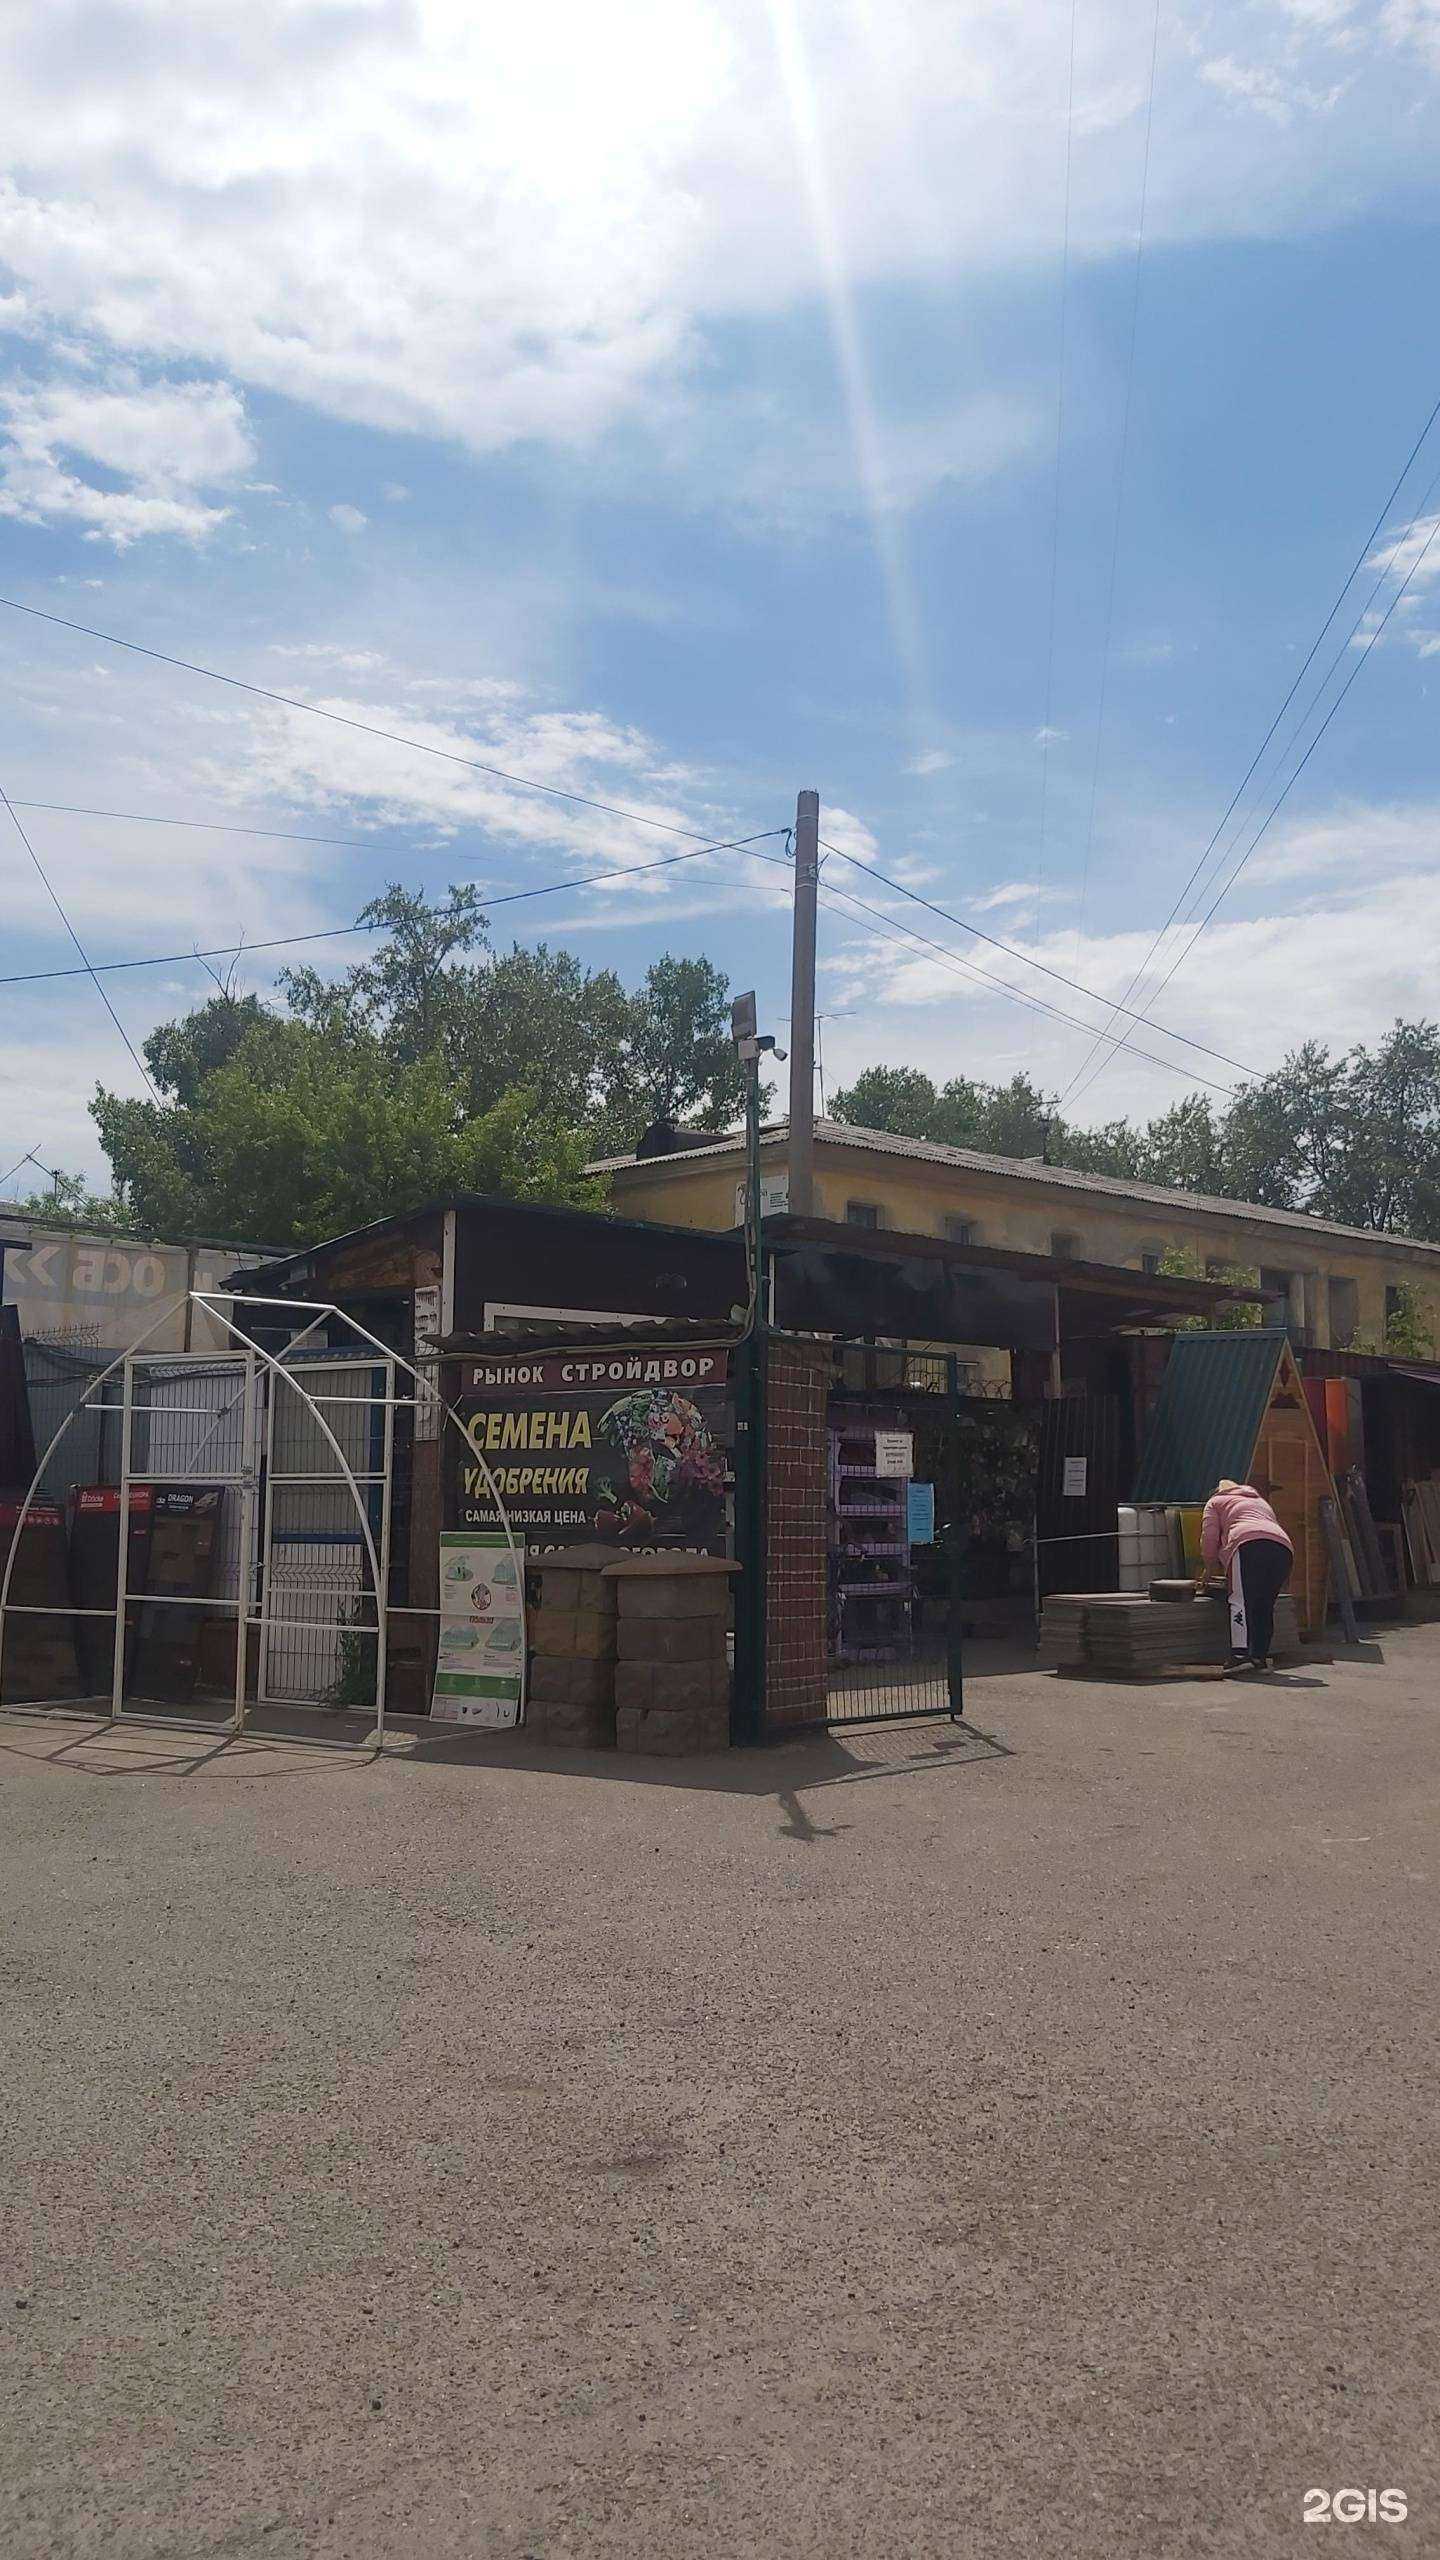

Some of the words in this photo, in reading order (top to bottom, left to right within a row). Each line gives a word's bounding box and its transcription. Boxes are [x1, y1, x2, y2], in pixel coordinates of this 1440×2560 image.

[473, 1366, 544, 1385] РЫНОК
[561, 1357, 714, 1382] СТРОЙДВОР
[467, 1410, 592, 1450] СЕМЕНА
[464, 1467, 589, 1498] УДОБРЕНИЯ
[167, 1493, 194, 1504] DRAGON
[465, 1509, 504, 1522] САМАЯ
[507, 1509, 551, 1523] НИЗКАЯ
[554, 1510, 586, 1525] ЦЕНА
